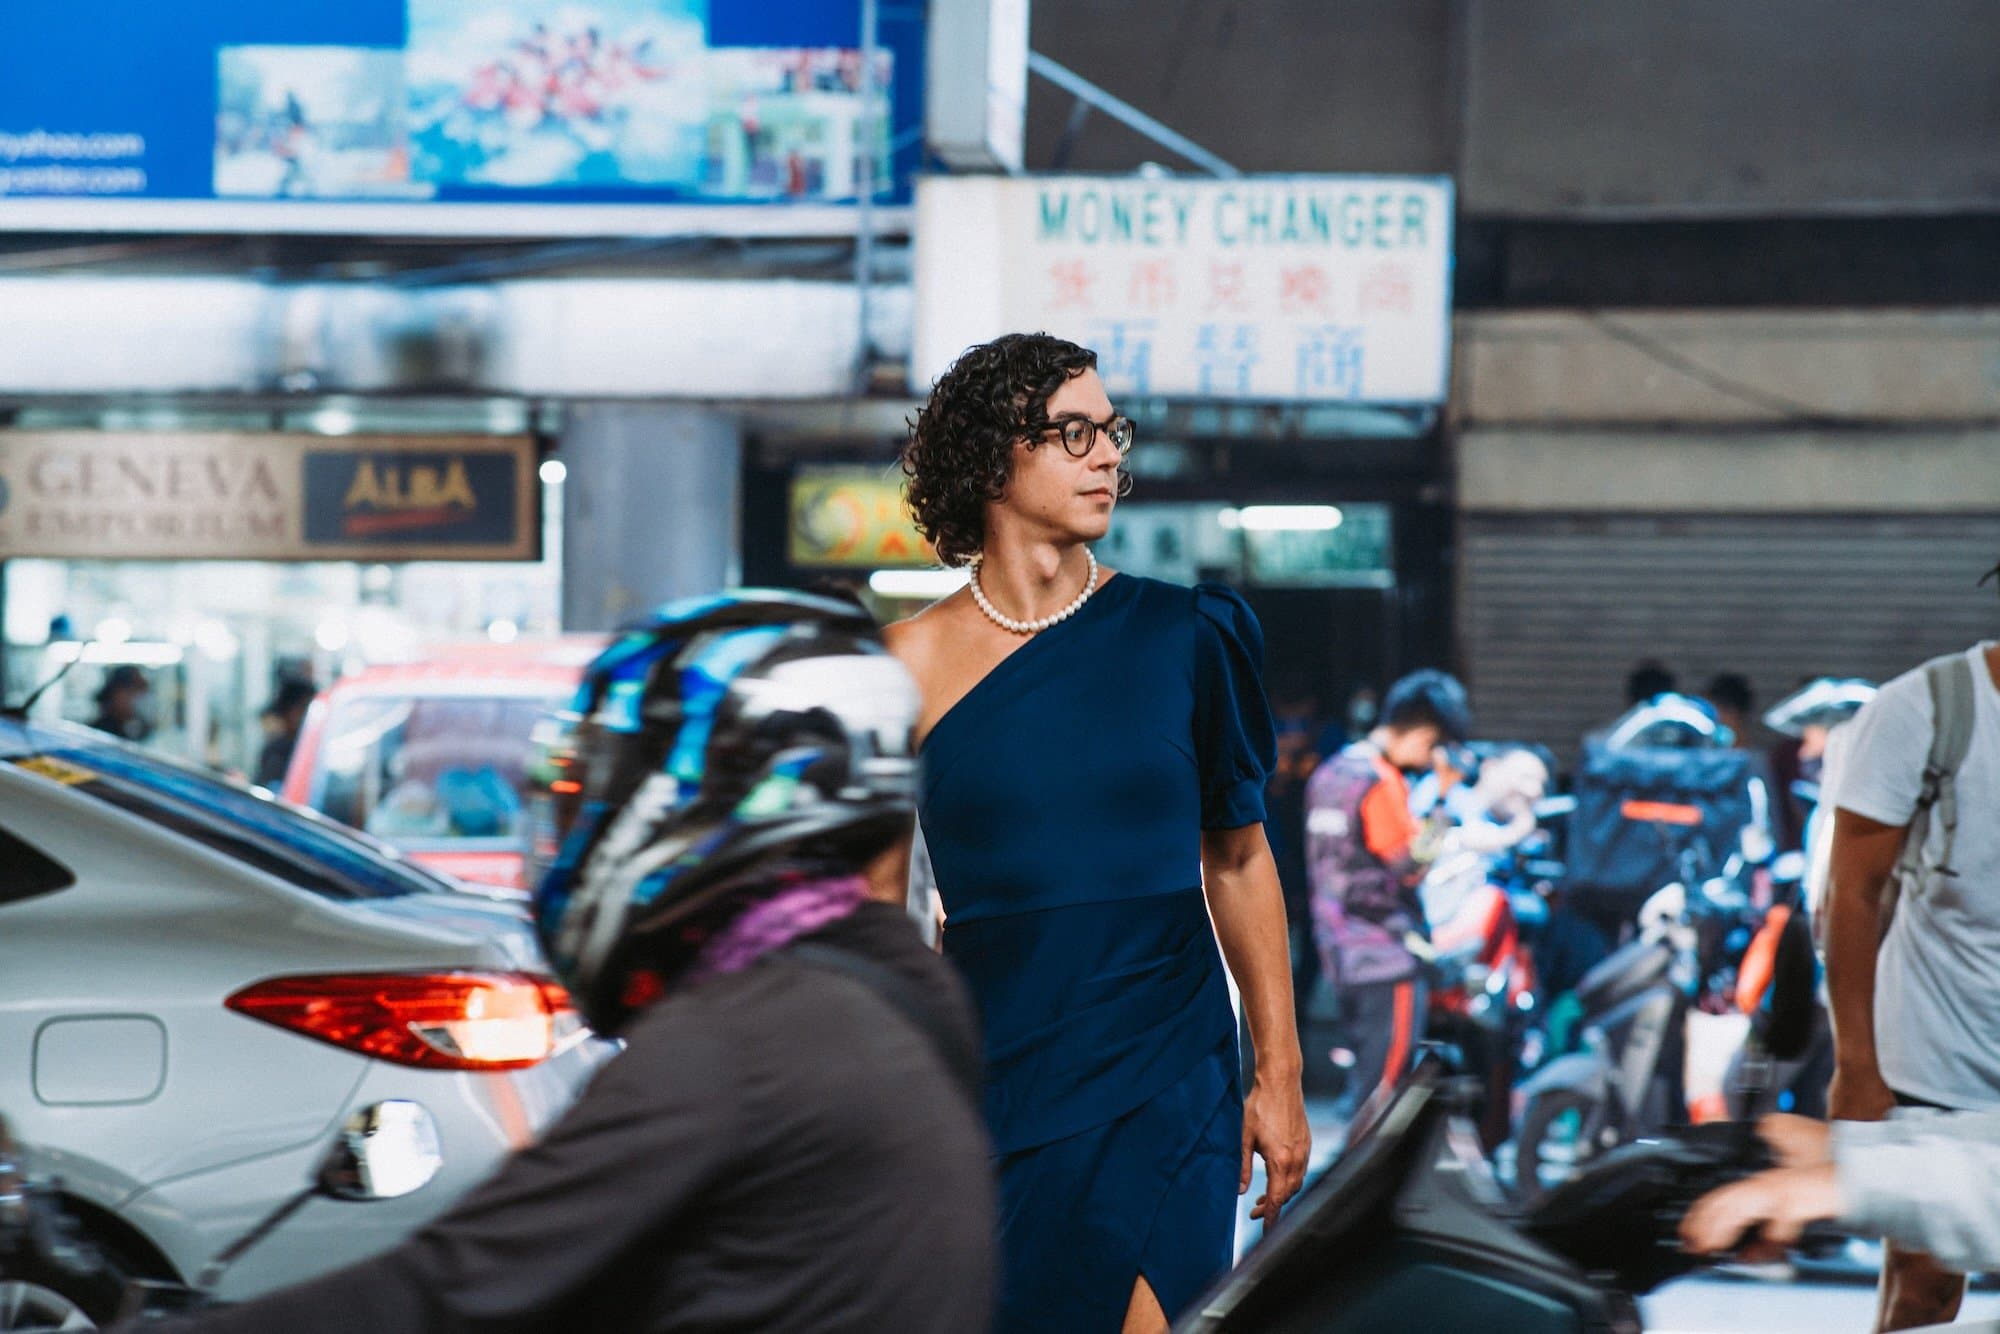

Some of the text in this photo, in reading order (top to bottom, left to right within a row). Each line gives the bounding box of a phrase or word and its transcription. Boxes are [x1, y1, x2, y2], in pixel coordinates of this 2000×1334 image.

[1037, 190, 1430, 248] MONEY CHANGER
[26, 451, 280, 498] GENEVA
[24, 509, 287, 539] EMPORIUM
